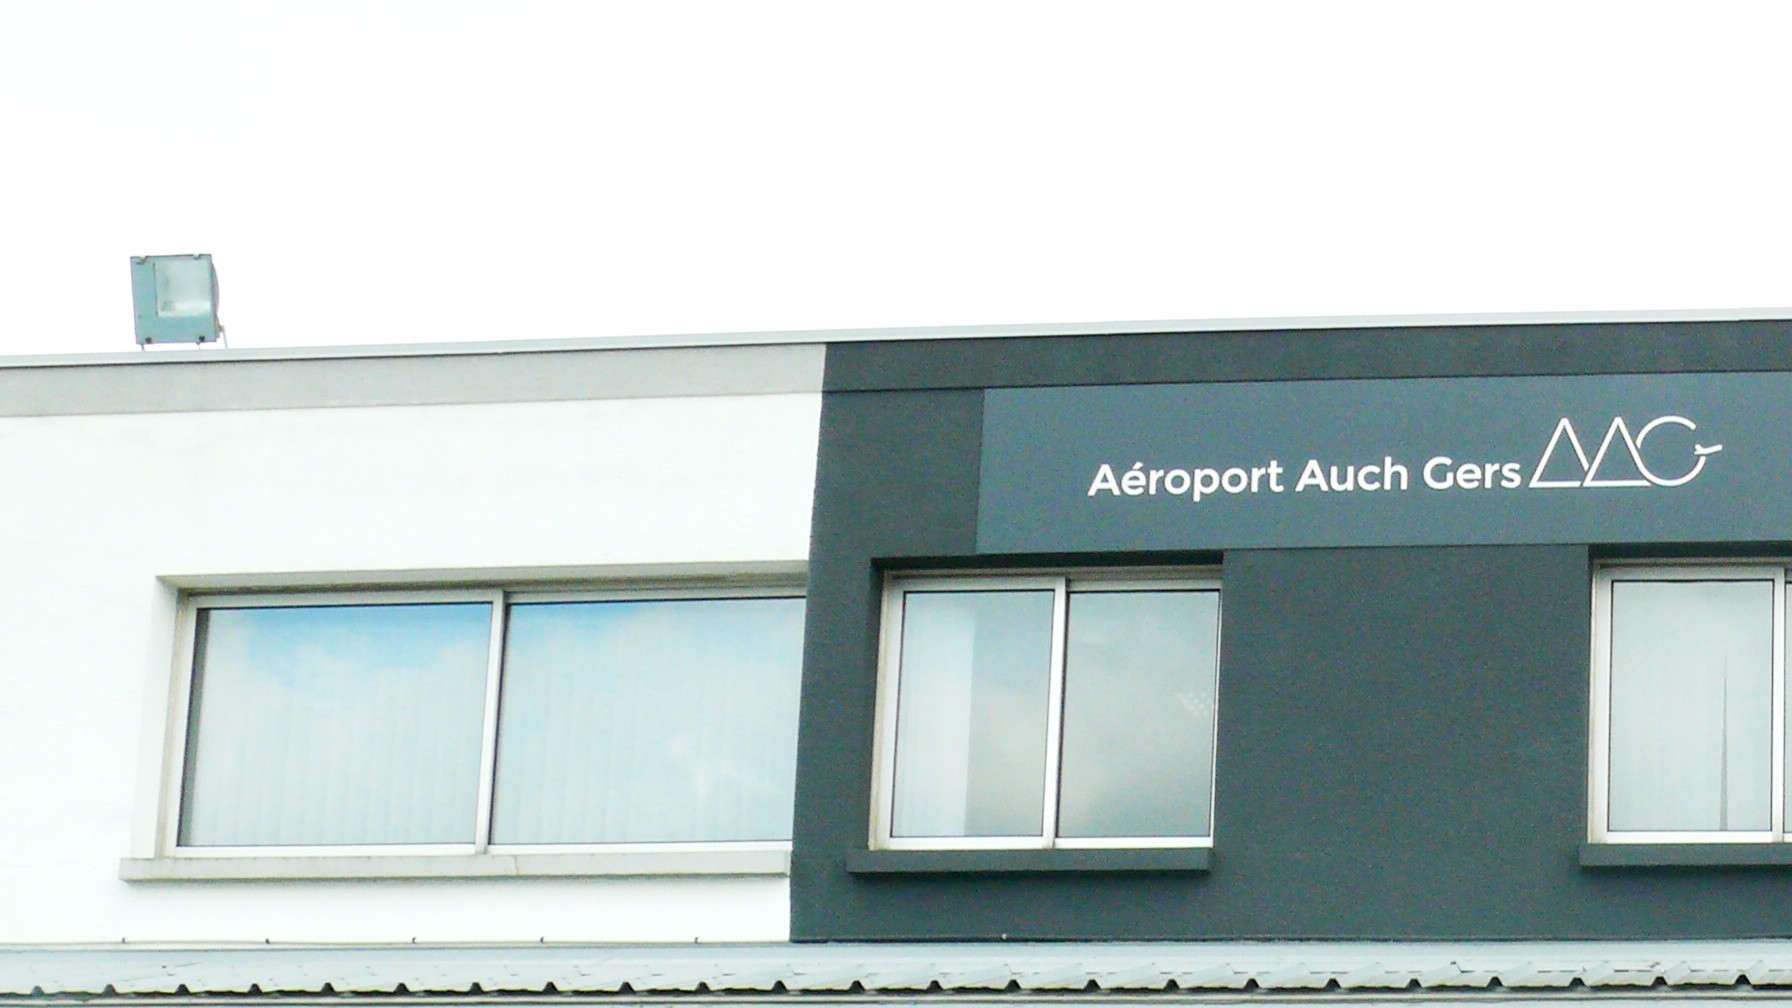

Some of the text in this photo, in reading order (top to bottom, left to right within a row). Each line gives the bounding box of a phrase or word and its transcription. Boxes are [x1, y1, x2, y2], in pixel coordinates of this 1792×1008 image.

[1087, 455, 1522, 502] Aéroport Auch Gers
